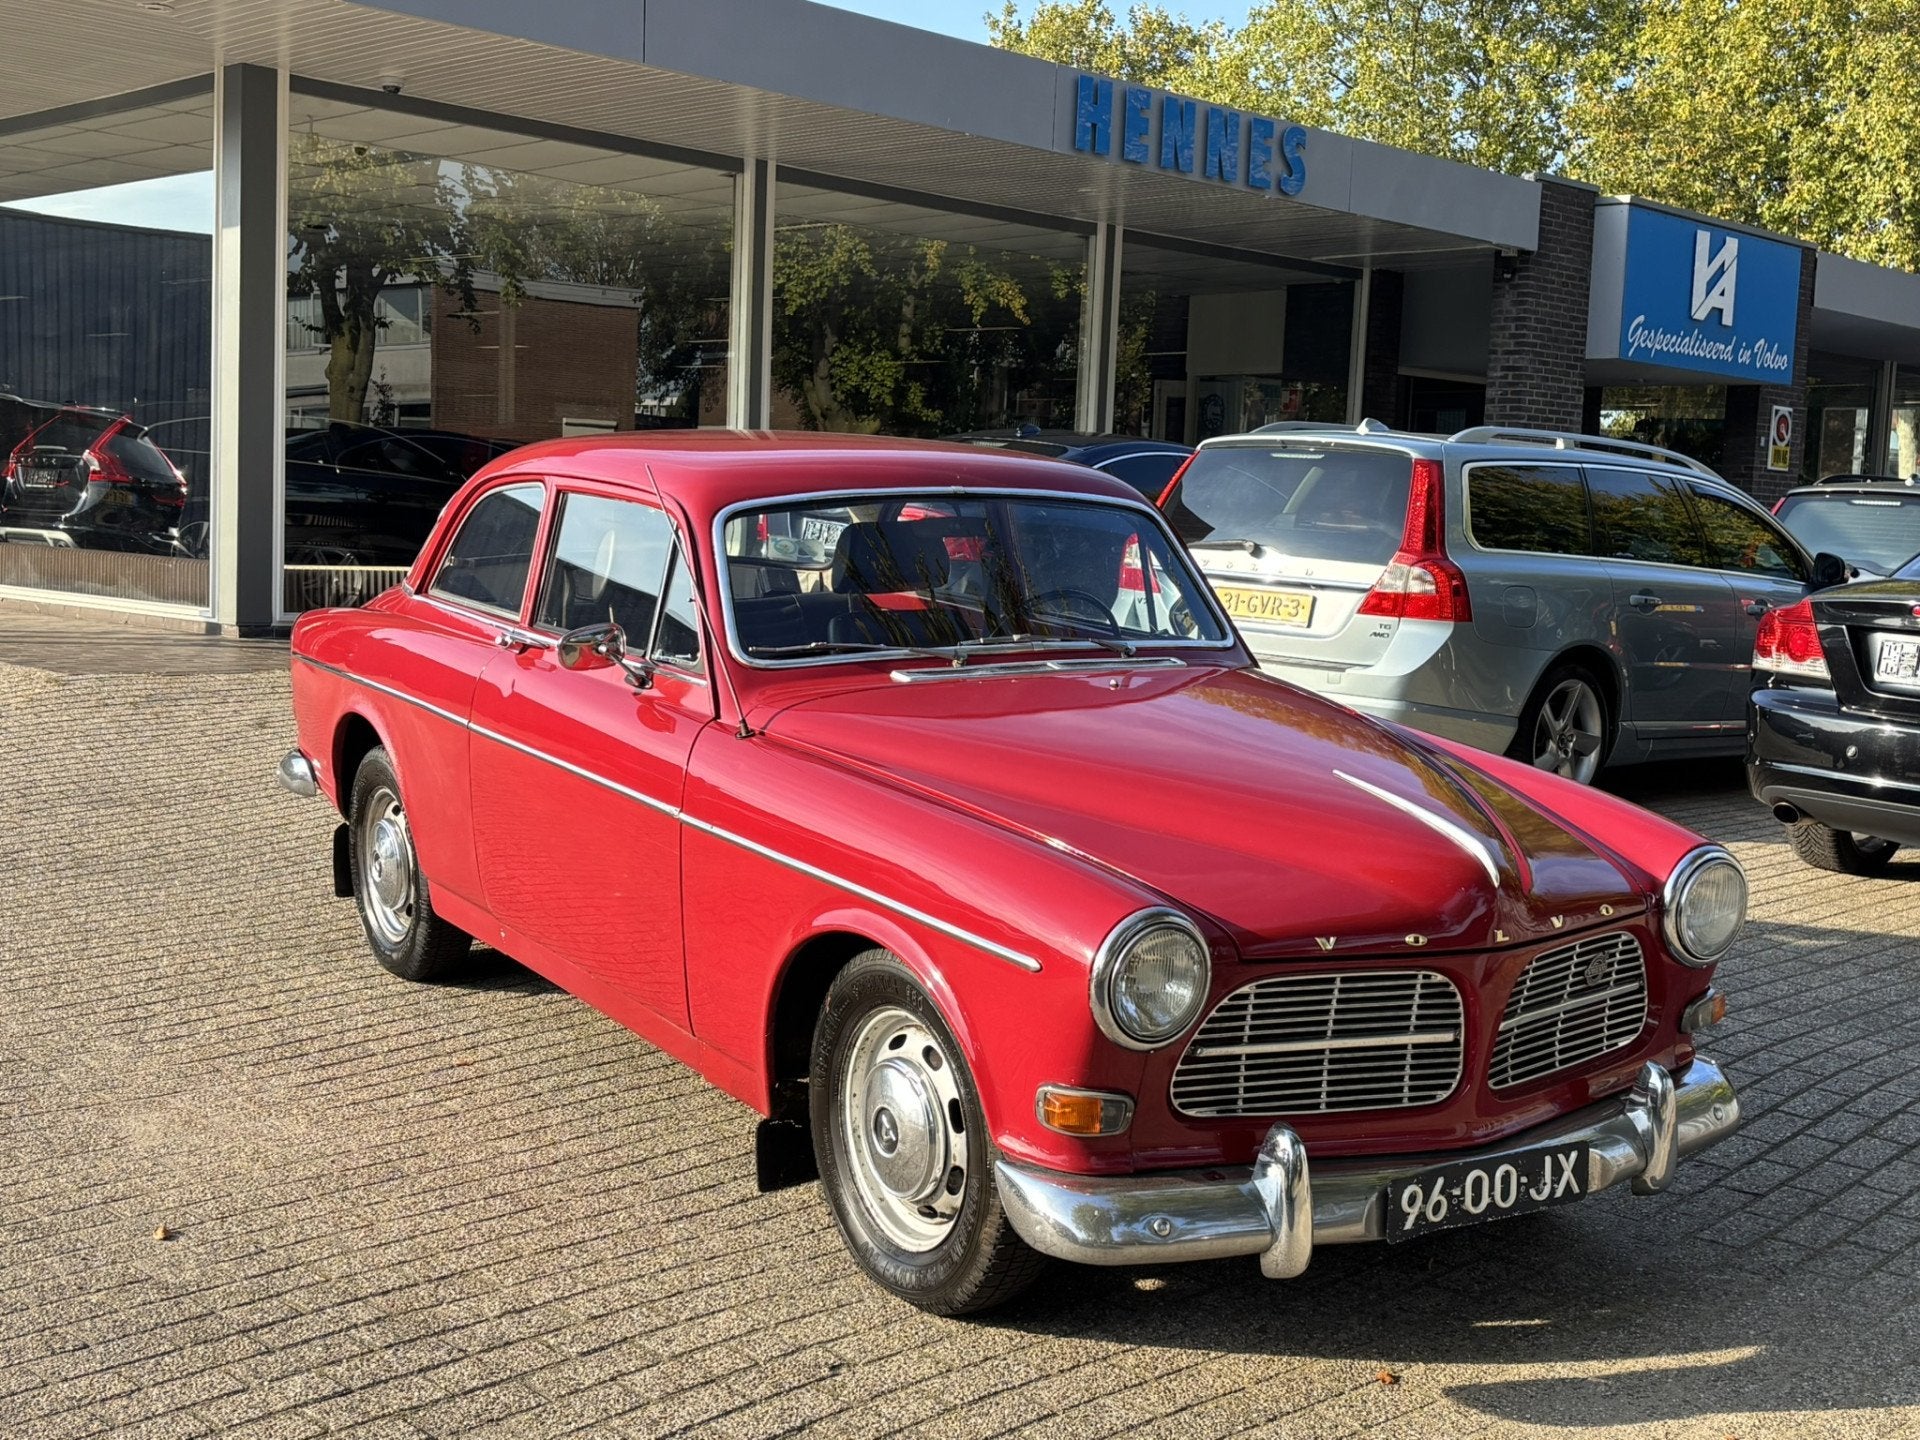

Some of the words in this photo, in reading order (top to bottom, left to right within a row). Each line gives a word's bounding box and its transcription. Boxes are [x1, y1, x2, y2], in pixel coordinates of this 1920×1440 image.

[1075, 75, 1307, 196] HENNES
[1628, 315, 1736, 363] Gespecialiseerd
[1738, 342, 1752, 364] in
[1754, 338, 1788, 370] Volvo
[1315, 904, 1613, 951] VOLVO
[1401, 1150, 1580, 1230] 96-00-JX
